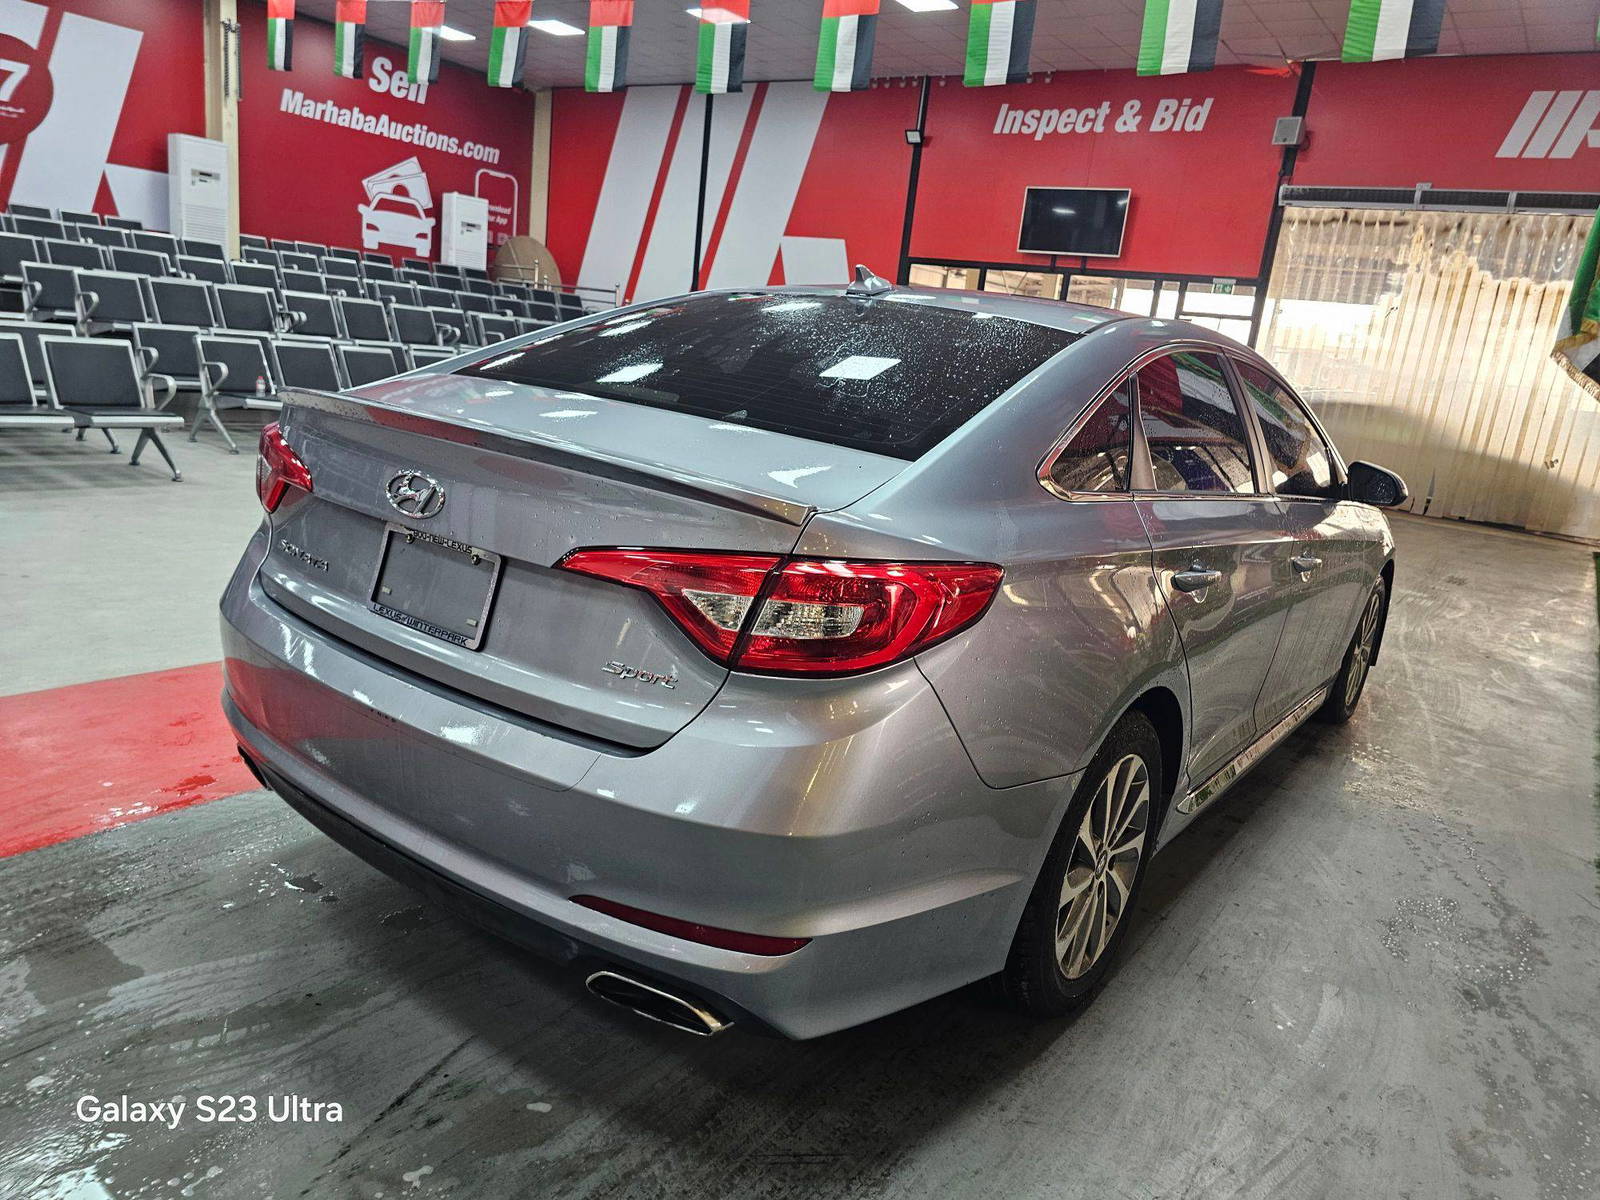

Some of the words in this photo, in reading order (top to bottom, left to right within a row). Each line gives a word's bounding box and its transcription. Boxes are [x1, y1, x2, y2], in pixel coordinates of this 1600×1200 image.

[280, 88, 500, 164] MarhabaAuctions.com
[993, 101, 1111, 141] Inspect
[1115, 99, 1143, 133] &
[1149, 98, 1215, 132] Bid
[601, 660, 679, 690] Sport
